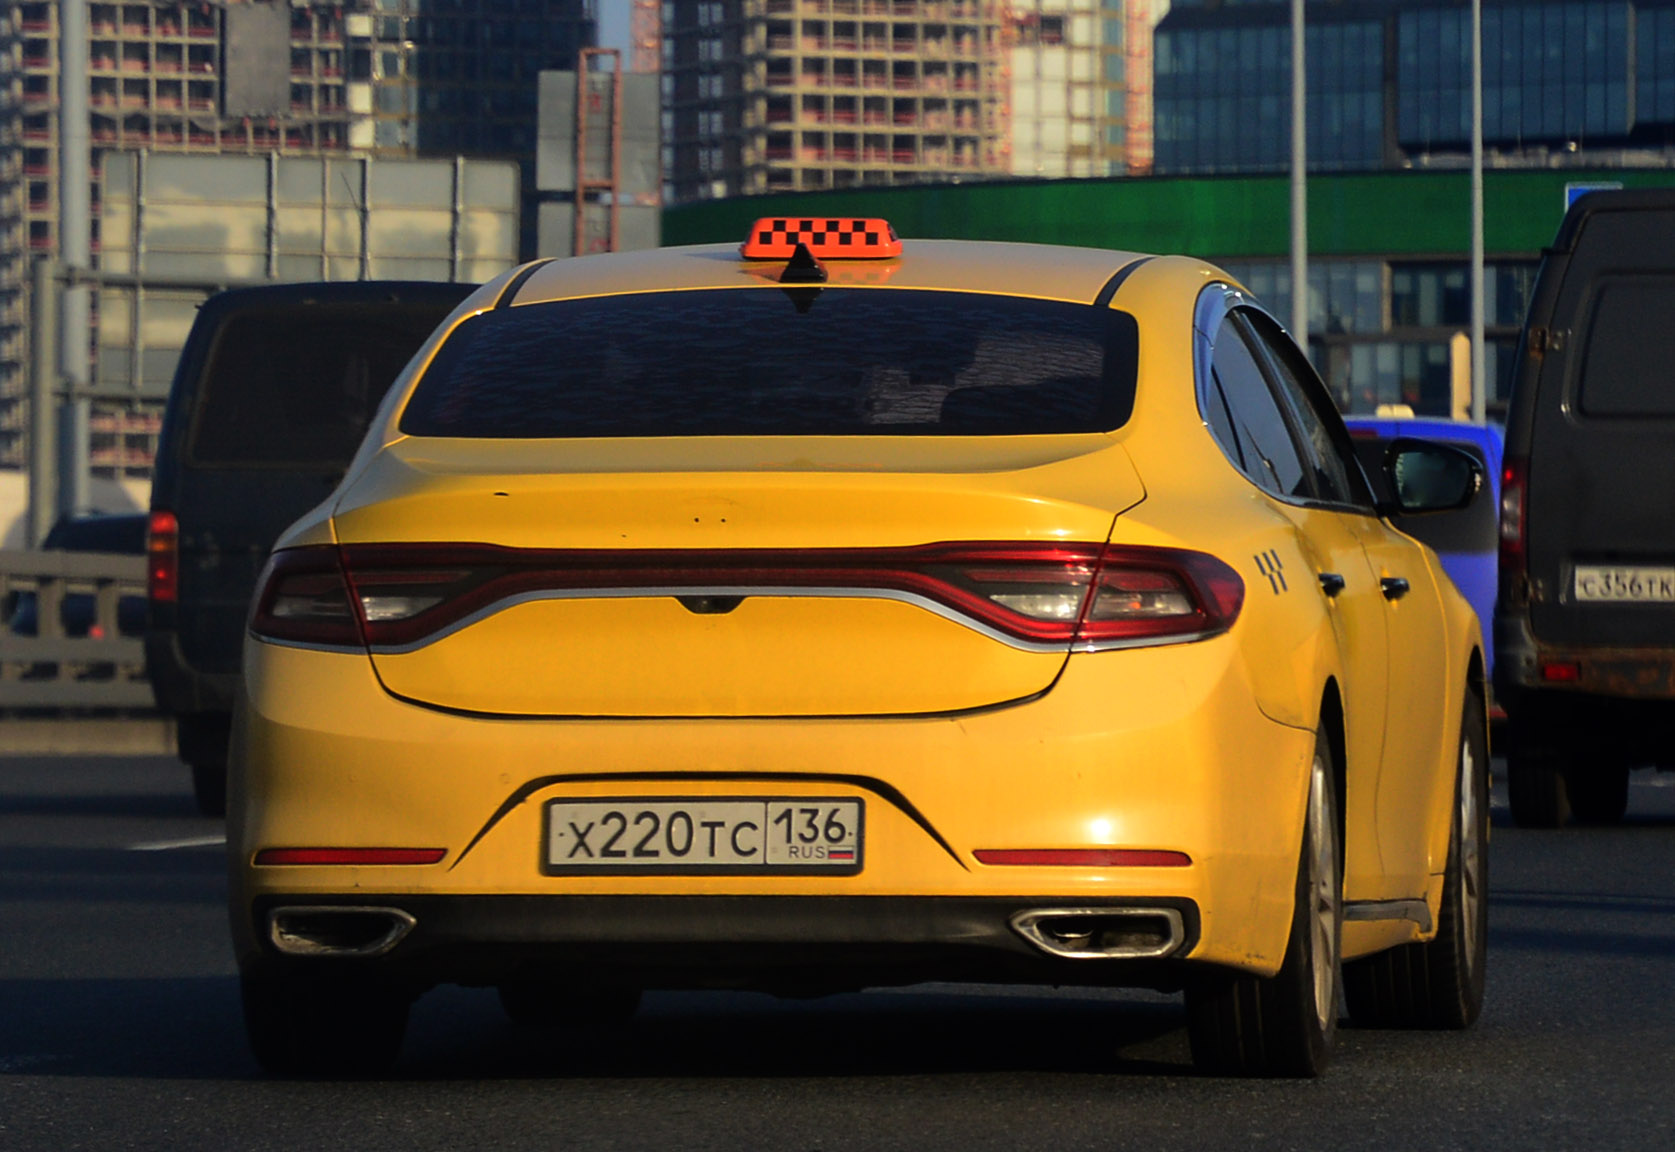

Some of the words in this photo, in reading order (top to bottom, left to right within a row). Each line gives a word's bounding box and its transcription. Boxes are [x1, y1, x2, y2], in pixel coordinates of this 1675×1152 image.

[567, 810, 758, 858] Х220ТС
[773, 807, 846, 844] 136
[789, 846, 825, 859] RUS
